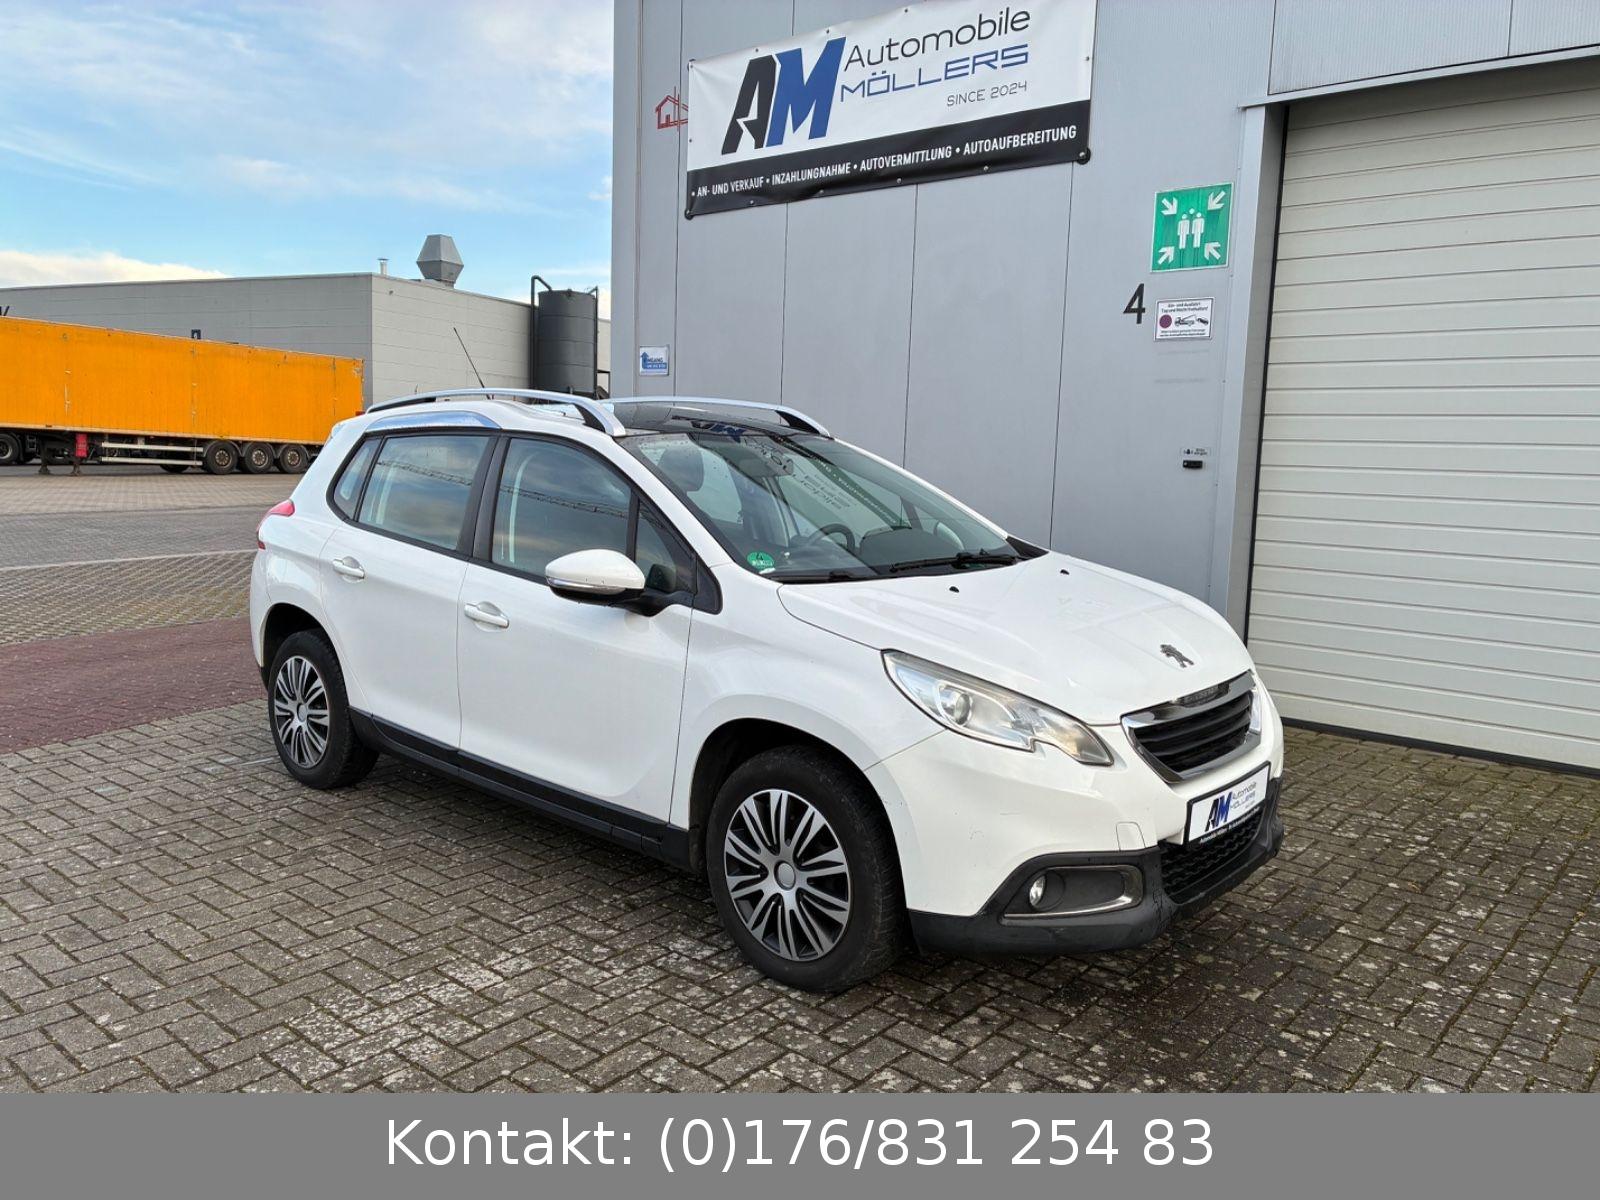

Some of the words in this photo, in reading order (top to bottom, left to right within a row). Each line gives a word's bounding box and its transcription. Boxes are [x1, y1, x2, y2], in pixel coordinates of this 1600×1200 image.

[844, 7, 1030, 71] Automobile
[721, 36, 846, 155] AM
[840, 44, 1029, 102] MÖLLERS
[947, 89, 986, 106] SINCE
[990, 81, 1028, 98] 2024
[697, 186, 711, 198] AN-
[712, 182, 729, 195] UND
[730, 176, 764, 193] VERKAUF
[771, 162, 851, 186] INZAHLUNGNAHME
[859, 146, 952, 173] AUTOVERMITTLUNG
[963, 125, 1077, 156] AUTOAUFBEREITUNG
[1123, 283, 1146, 324] 4
[1205, 791, 1233, 832] AM
